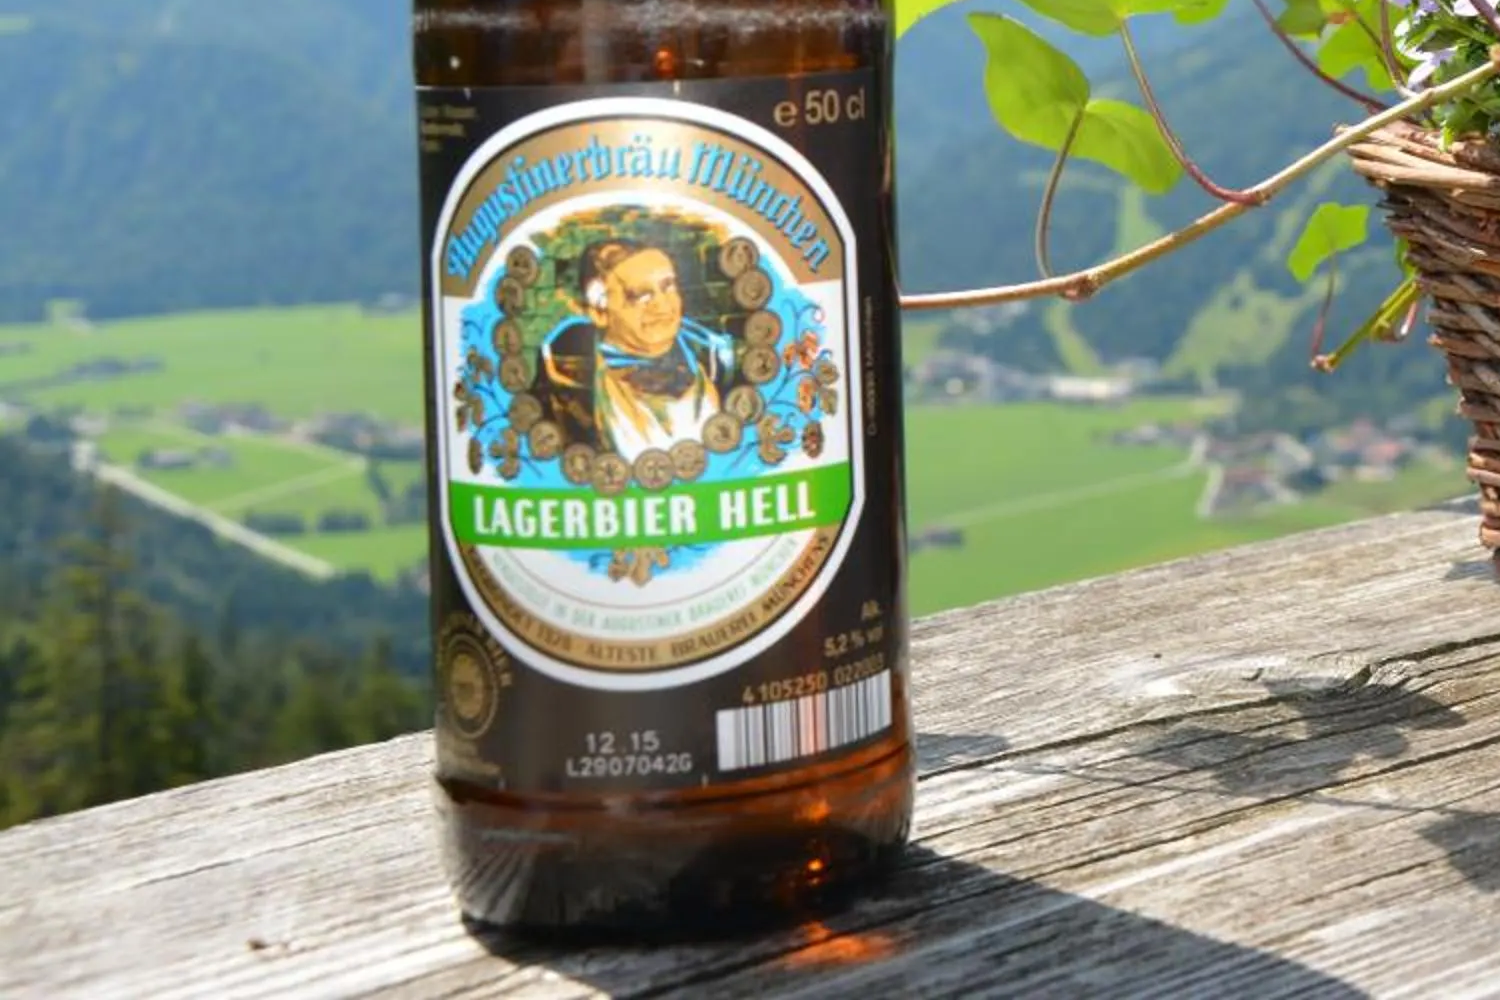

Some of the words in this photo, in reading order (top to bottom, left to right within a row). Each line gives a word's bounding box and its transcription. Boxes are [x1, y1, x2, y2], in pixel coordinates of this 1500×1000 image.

[804, 89, 839, 125] 50
[688, 139, 831, 274] München
[473, 494, 697, 540] LAGERBIER
[718, 480, 816, 531] HELL
[742, 686, 755, 703] 4
